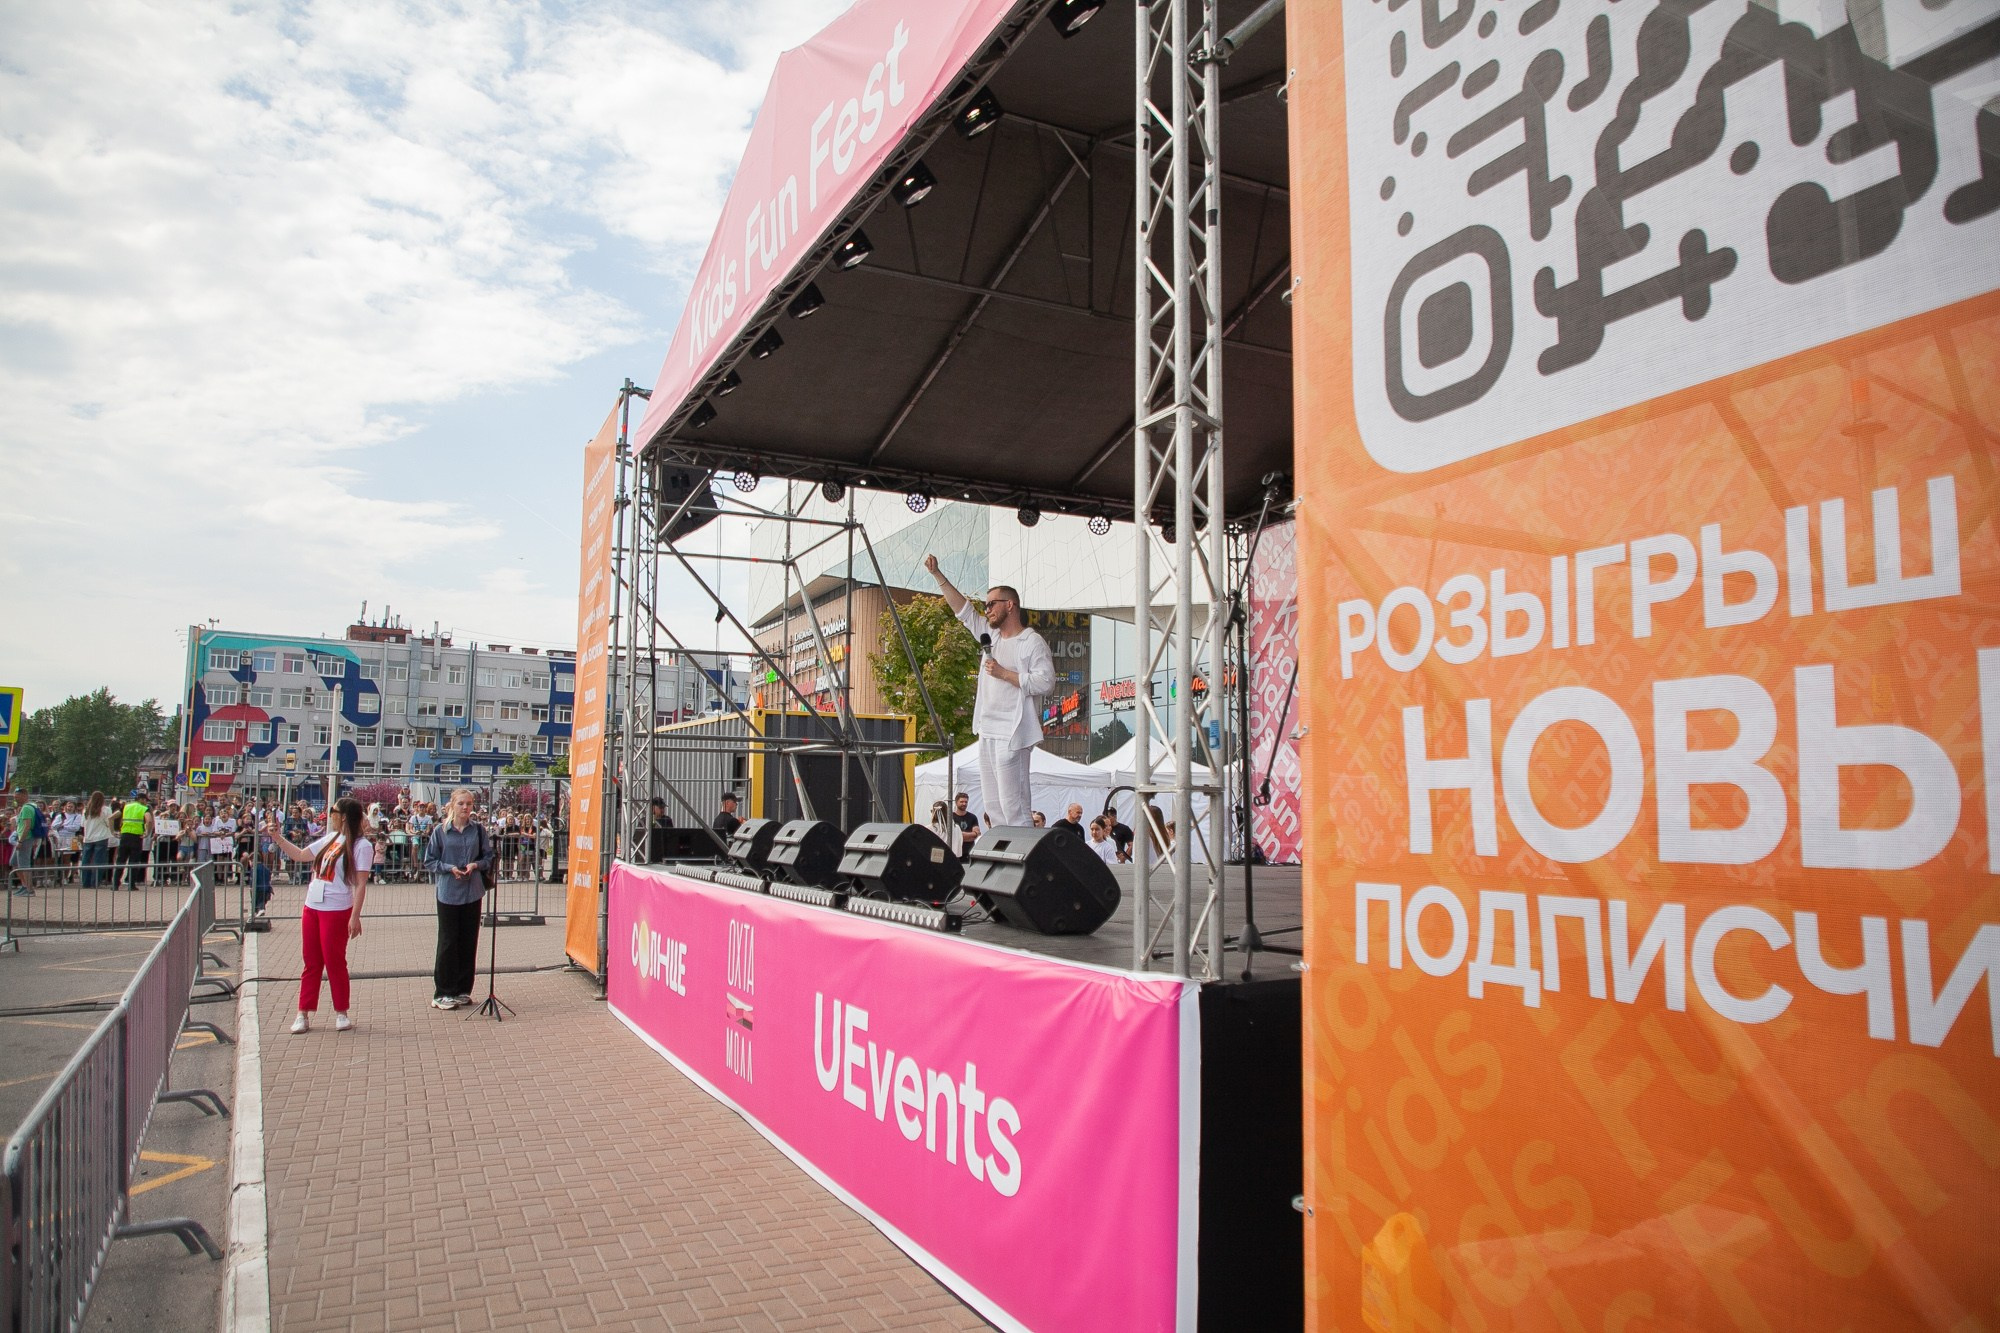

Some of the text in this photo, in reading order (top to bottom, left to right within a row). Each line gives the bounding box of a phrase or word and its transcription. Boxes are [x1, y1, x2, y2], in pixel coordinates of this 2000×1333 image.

[688, 18, 910, 368] Kids Fun Fest
[820, 618, 847, 638] ОКМАНН
[1337, 475, 1962, 680] РОЗЫГРЫШ
[727, 918, 755, 996] ОХТА
[725, 1026, 753, 1085] МОЛЛ
[814, 991, 1022, 1197] UEvents
